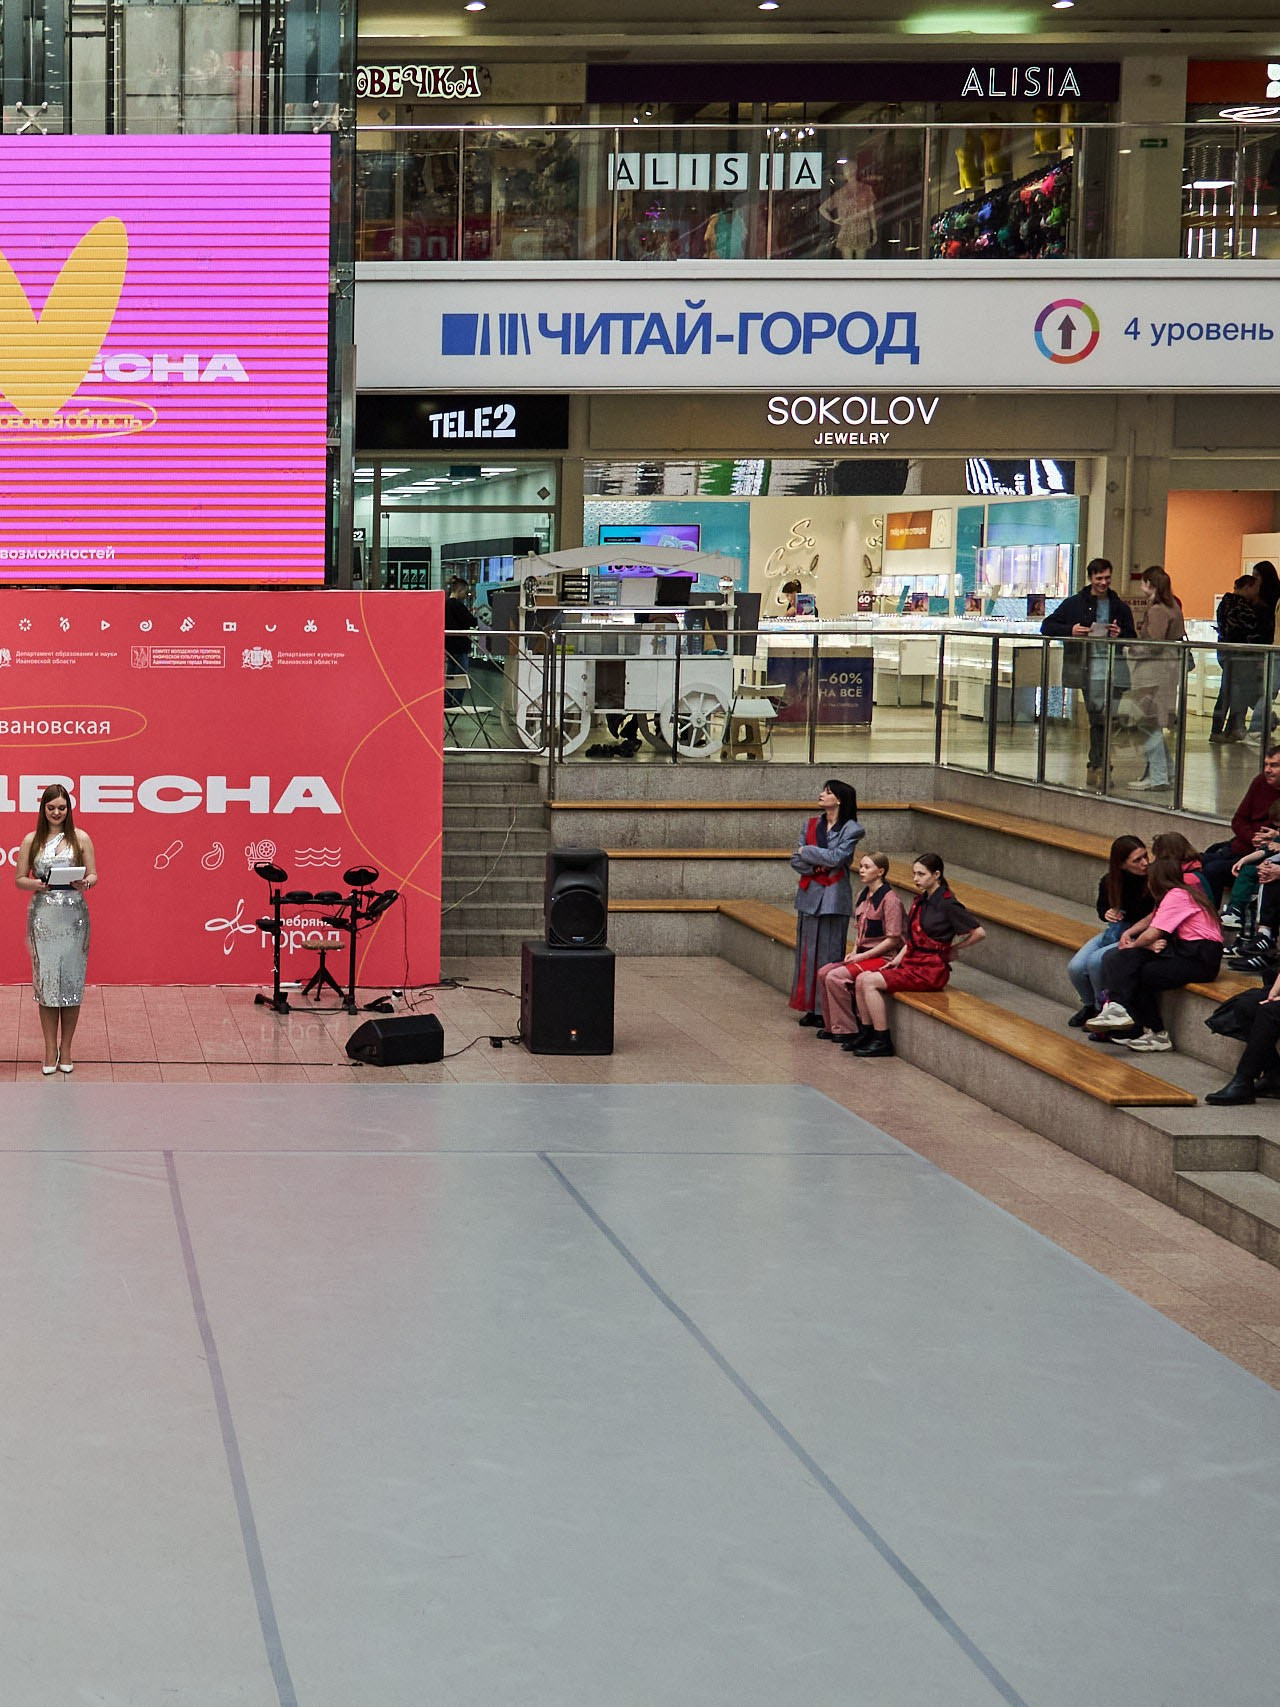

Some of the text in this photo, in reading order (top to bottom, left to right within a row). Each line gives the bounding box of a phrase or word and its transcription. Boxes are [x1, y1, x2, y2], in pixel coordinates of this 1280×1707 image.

[961, 67, 1080, 96] ALISIA
[537, 299, 920, 365] ЧИТАЙ-ГОРОД
[1124, 317, 1274, 346] 4 уровень
[429, 403, 516, 439] TELE2
[767, 396, 939, 426] SOKOLOV
[814, 432, 889, 445] JEWELRY
[0, 545, 115, 560] возможностей
